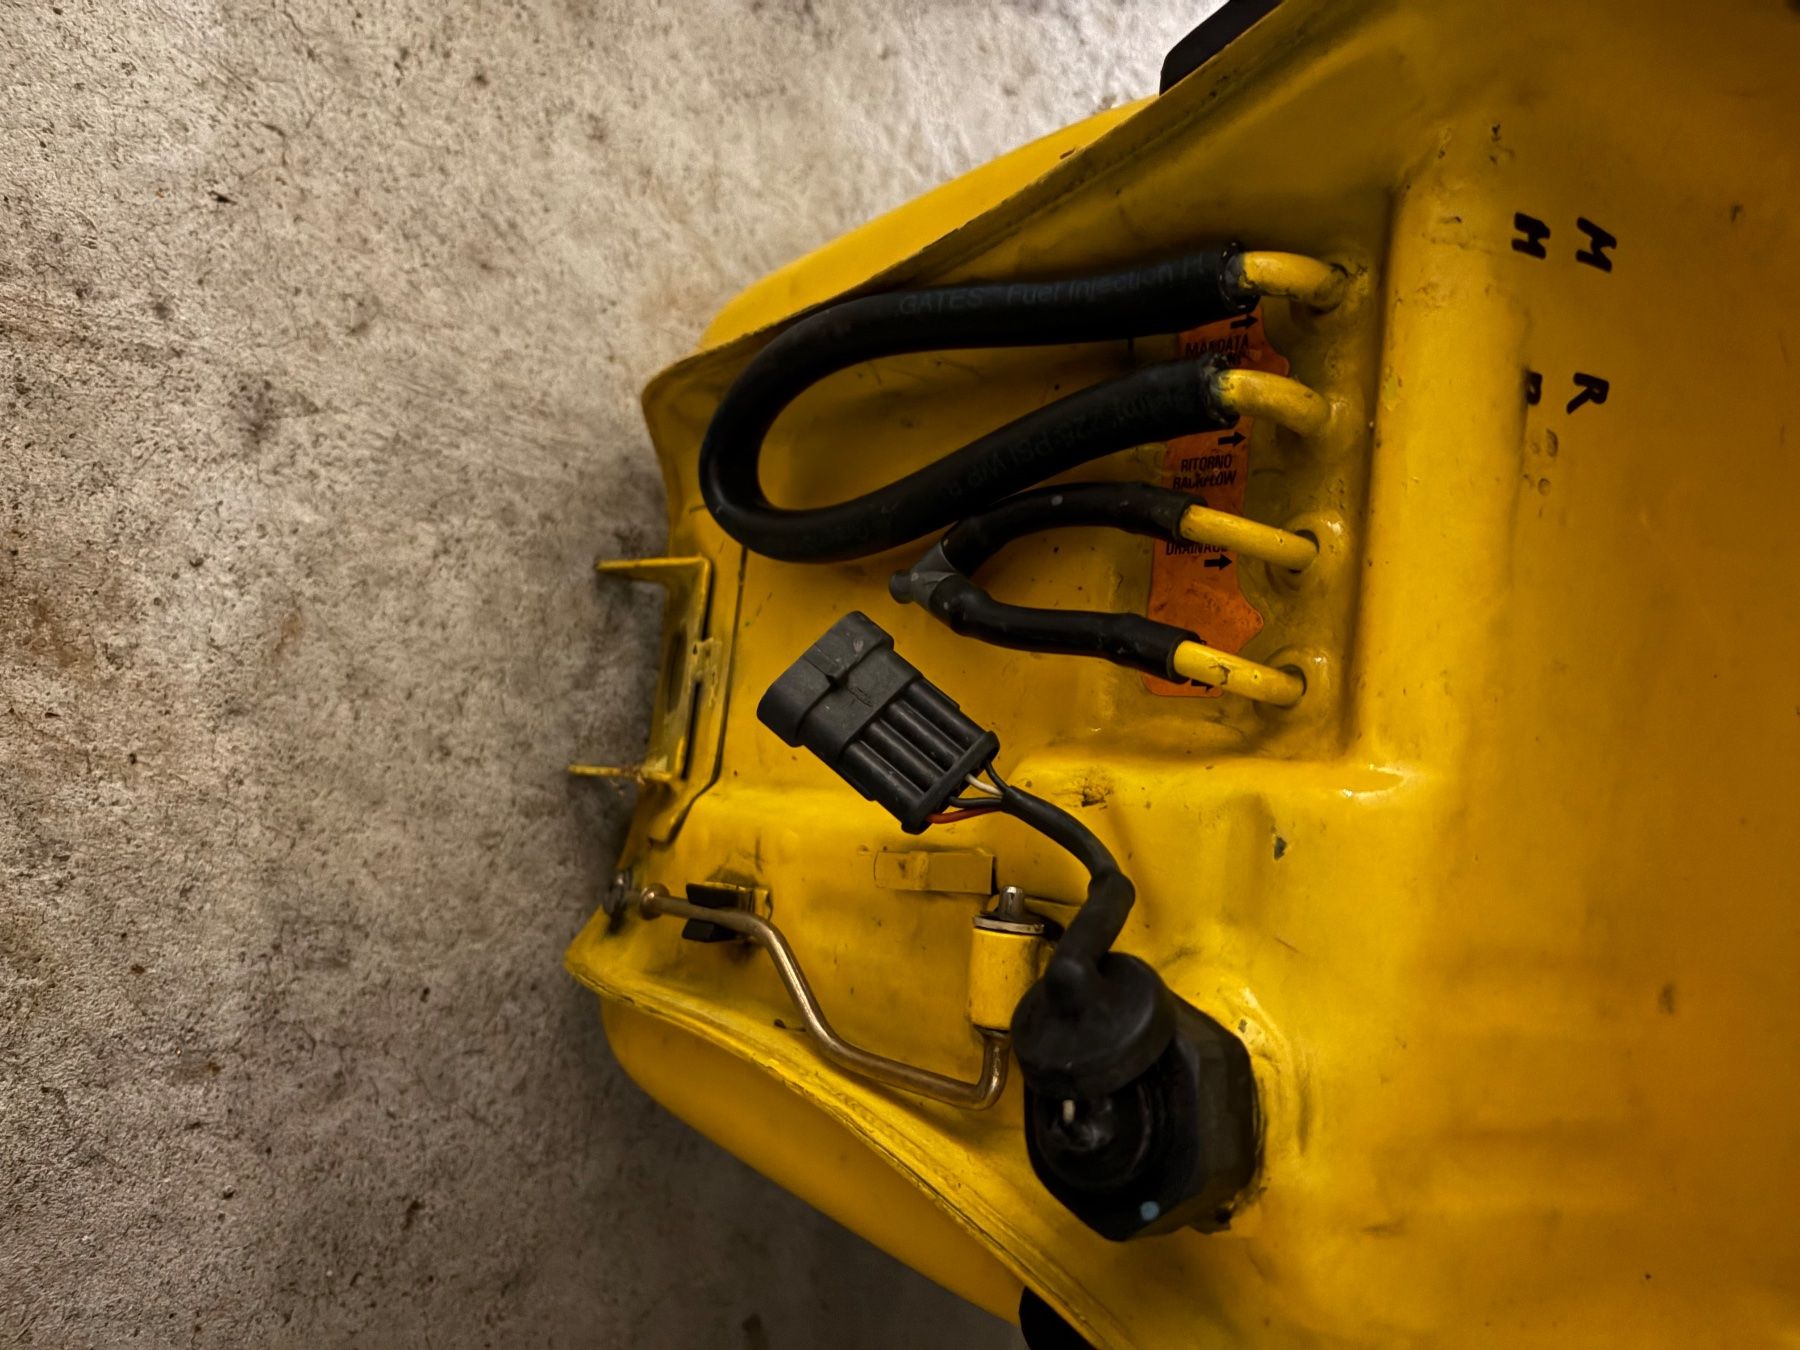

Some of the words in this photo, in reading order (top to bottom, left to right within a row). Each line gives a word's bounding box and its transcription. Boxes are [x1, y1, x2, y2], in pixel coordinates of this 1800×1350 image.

[1575, 215, 1617, 273] M
[899, 286, 982, 315] GATES
[1007, 280, 1059, 306] Fuel
[1068, 260, 1172, 302] Injection
[1185, 334, 1248, 360] MANDATA
[1566, 371, 1609, 414] R
[1181, 453, 1233, 472] RITORNO
